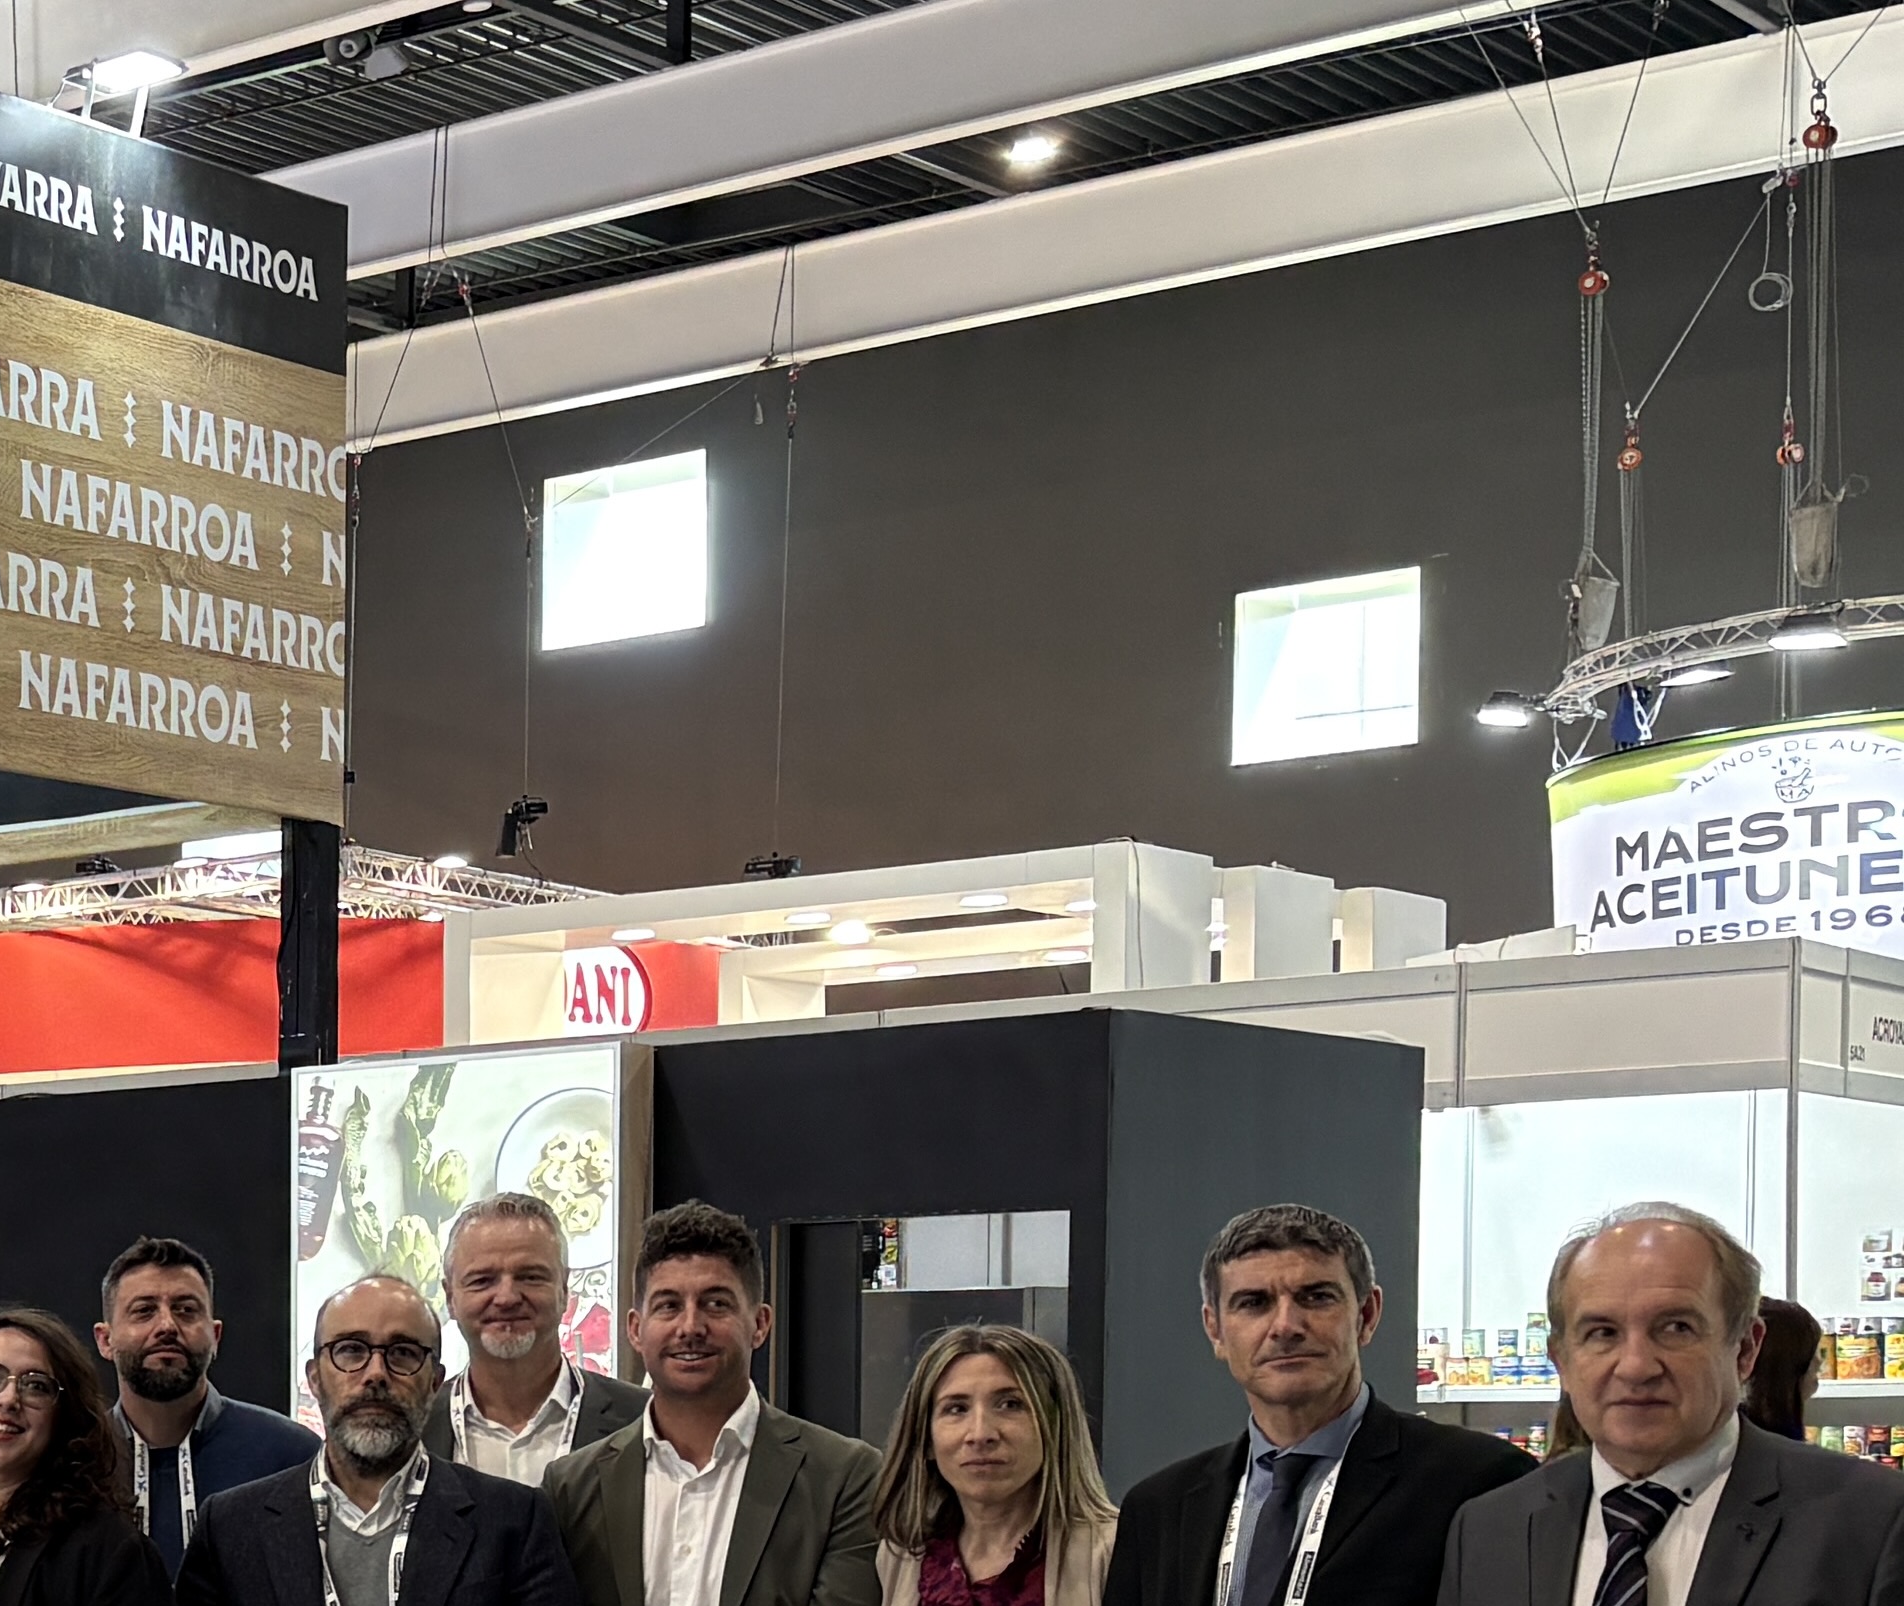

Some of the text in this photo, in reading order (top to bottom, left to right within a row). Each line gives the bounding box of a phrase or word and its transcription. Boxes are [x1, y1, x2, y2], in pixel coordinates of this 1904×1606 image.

[142, 204, 319, 302] NAFARROA
[20, 458, 258, 570] NAFARROA
[18, 649, 257, 749] NAFARROA
[1784, 738, 1818, 752] DE
[1616, 800, 1904, 877] MAESTR
[1589, 849, 1904, 933] ACEITUNE
[1675, 916, 1797, 946] DESDE
[565, 962, 632, 1026] ANI
